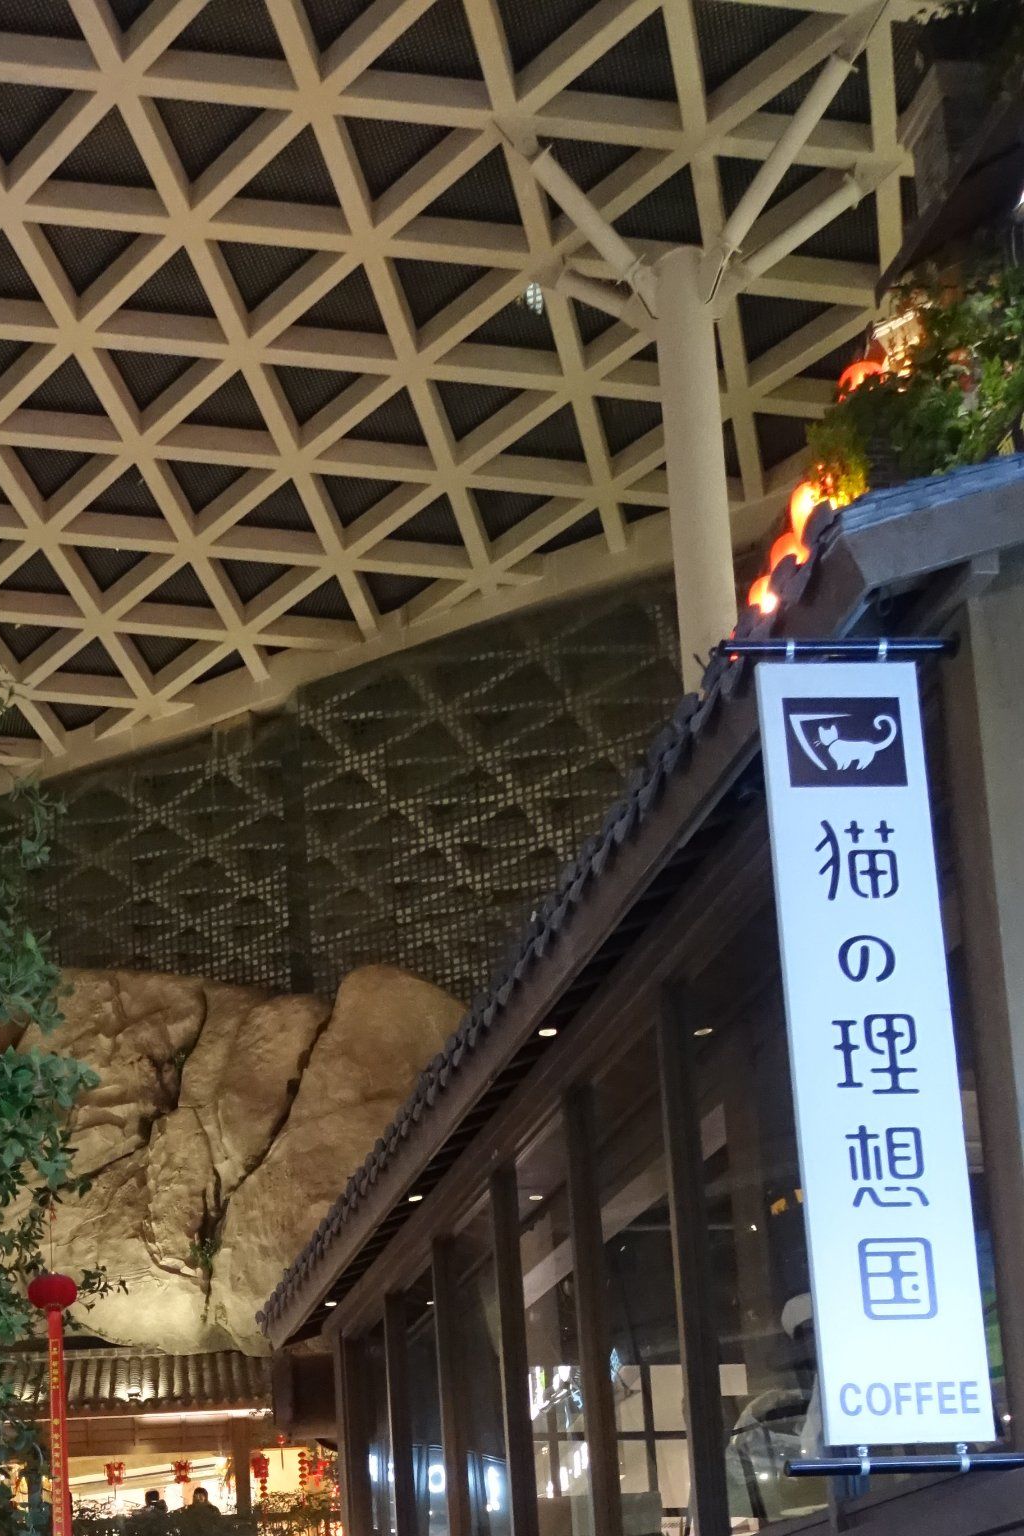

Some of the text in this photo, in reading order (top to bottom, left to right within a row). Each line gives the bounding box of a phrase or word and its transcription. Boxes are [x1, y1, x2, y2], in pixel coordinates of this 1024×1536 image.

[815, 819, 939, 1321] 猫の理想国
[839, 1381, 981, 1418] COFFEE
